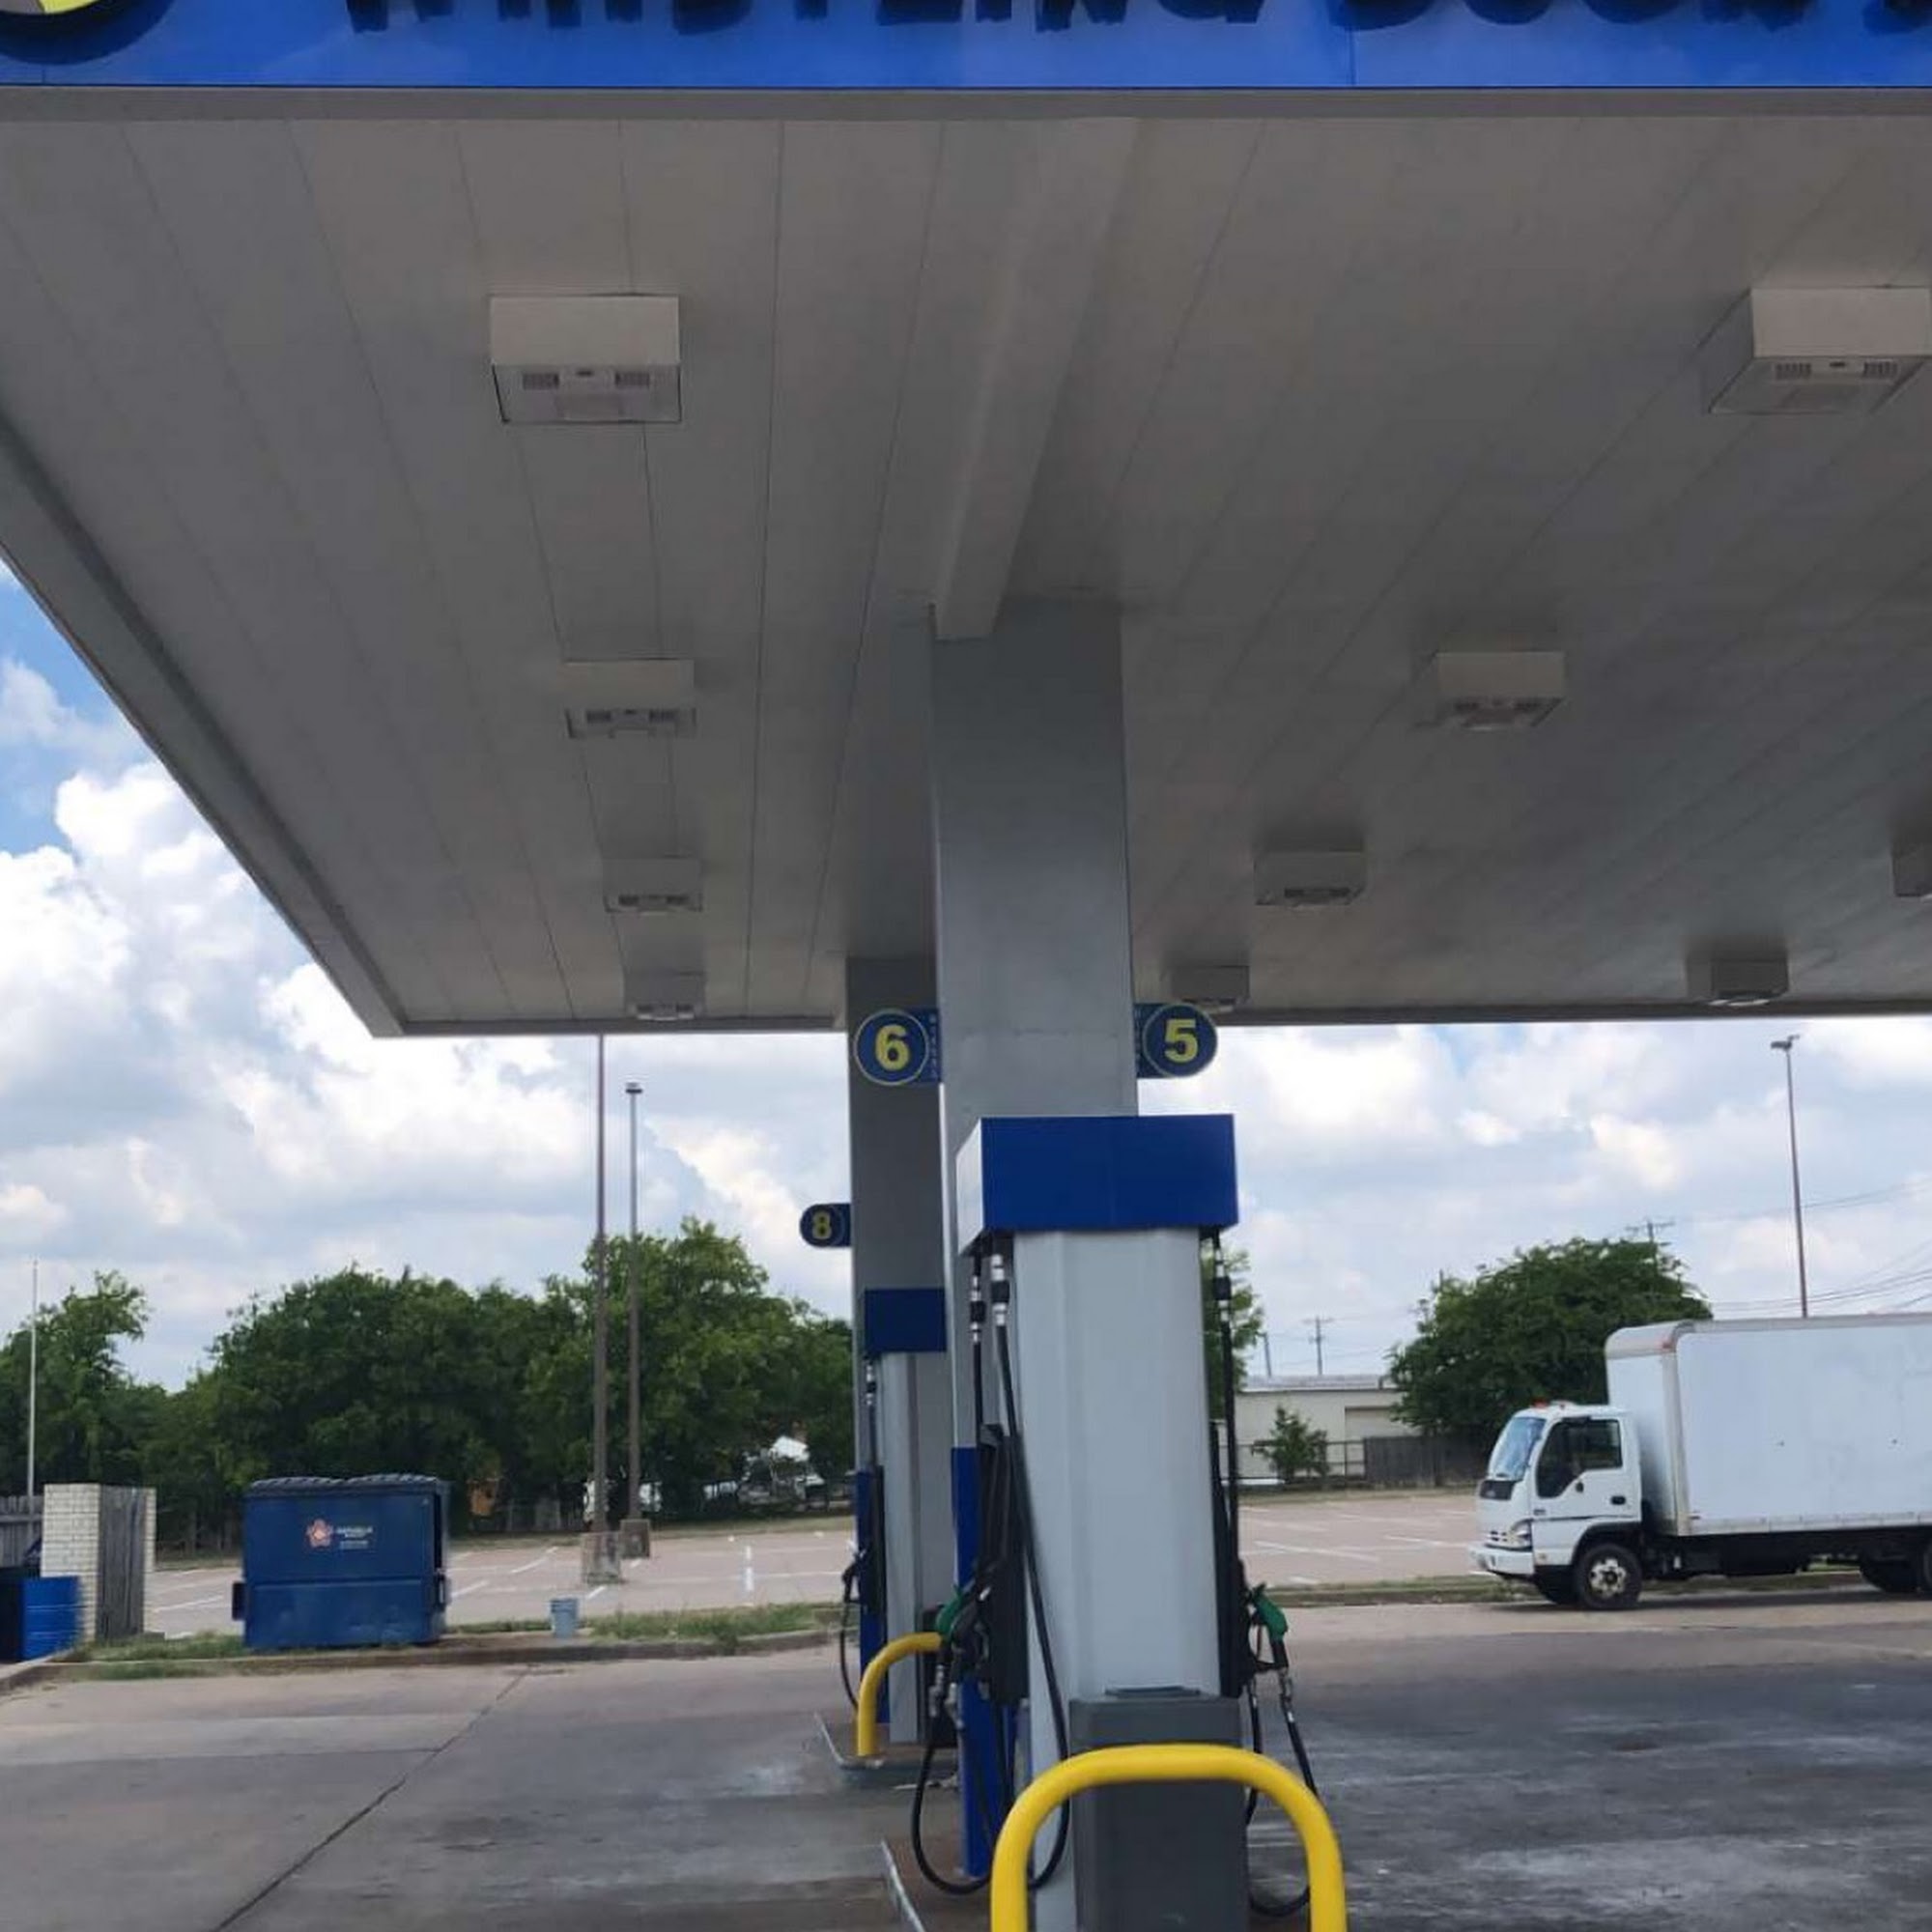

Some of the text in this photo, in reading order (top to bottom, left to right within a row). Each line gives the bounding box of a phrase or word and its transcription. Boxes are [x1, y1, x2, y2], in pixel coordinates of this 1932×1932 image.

[875, 1024, 910, 1071] 6
[1164, 1018, 1198, 1064] 5
[812, 1211, 832, 1240] 8
